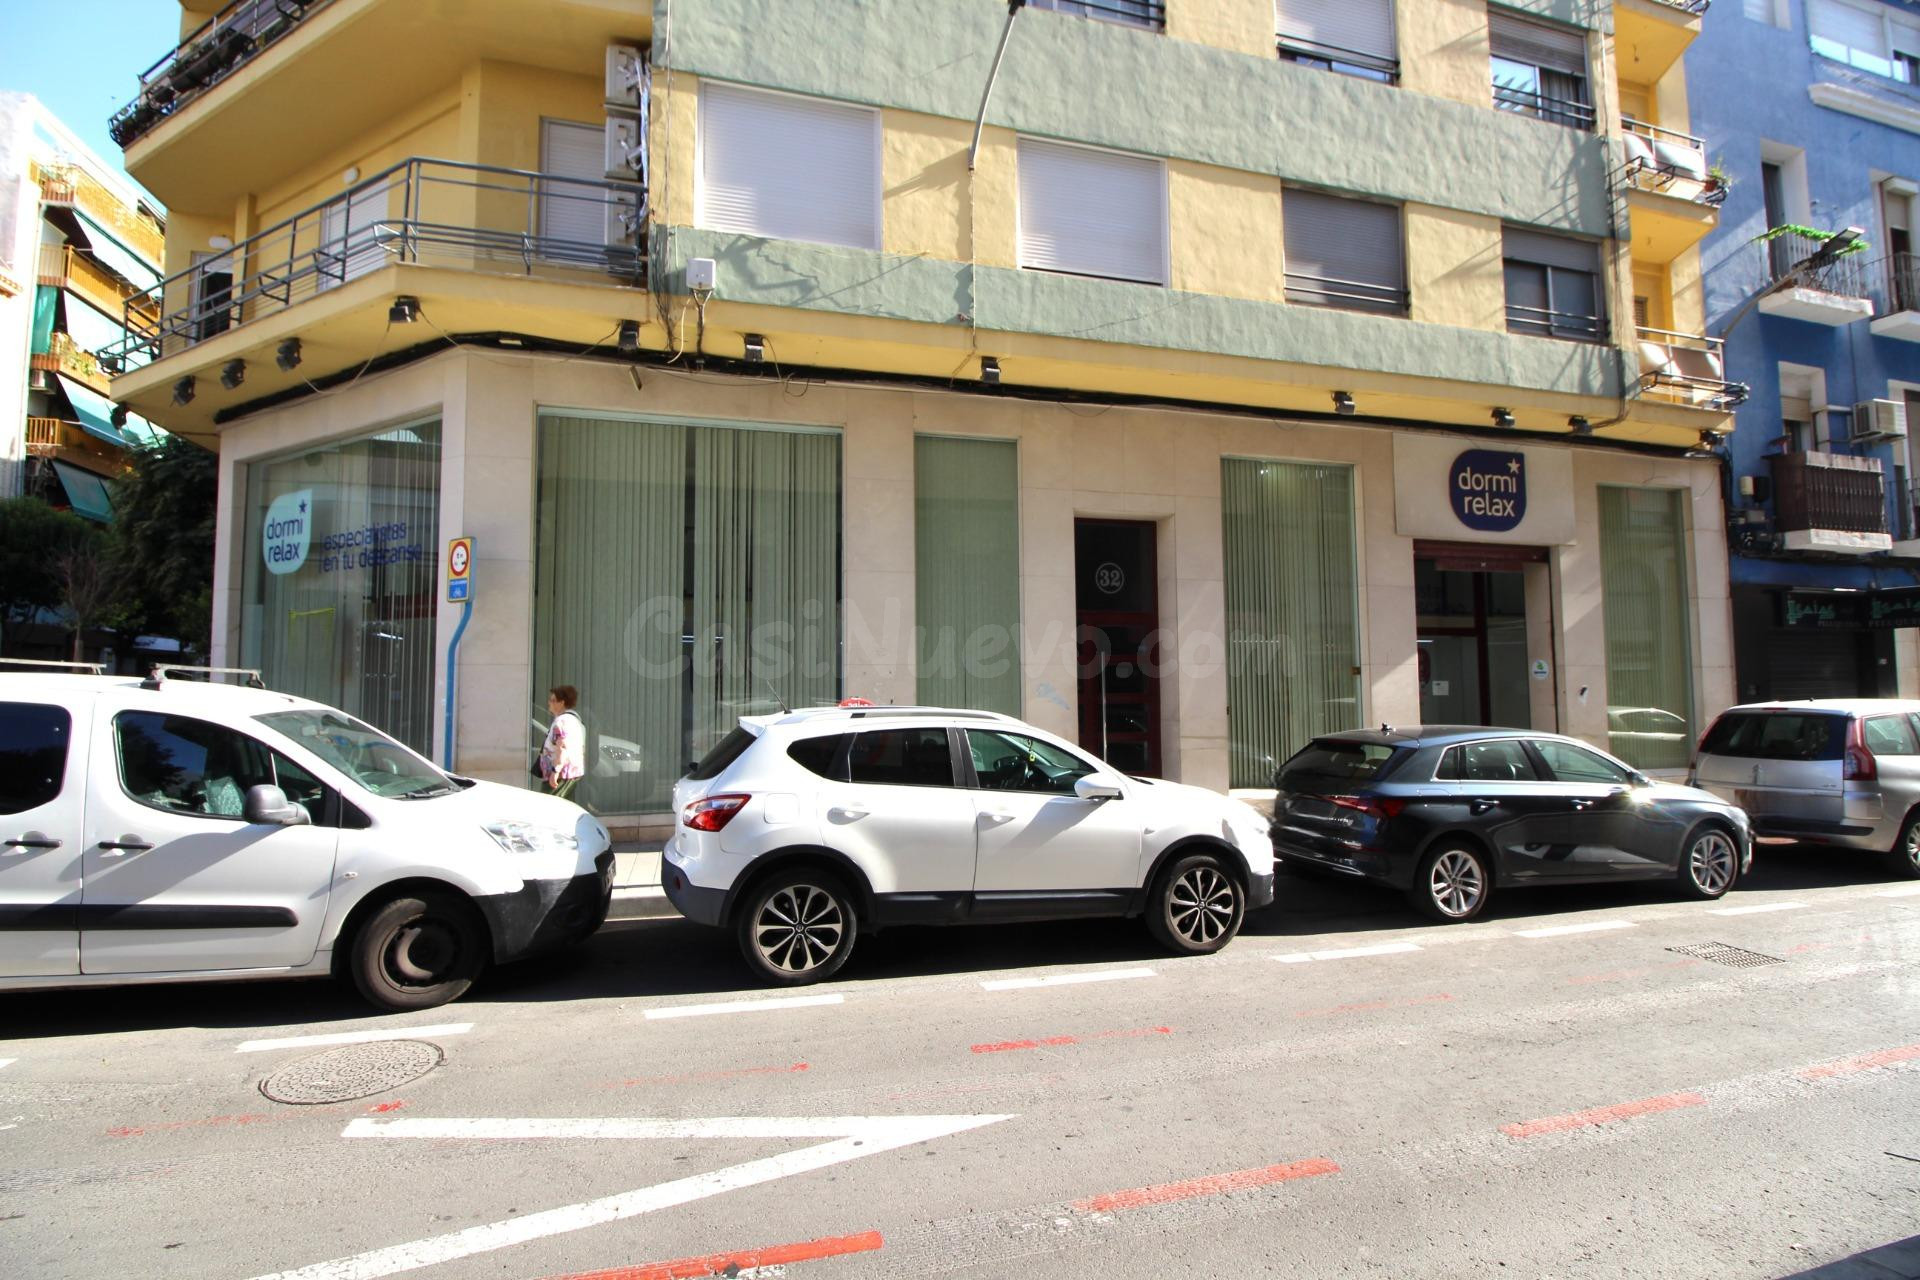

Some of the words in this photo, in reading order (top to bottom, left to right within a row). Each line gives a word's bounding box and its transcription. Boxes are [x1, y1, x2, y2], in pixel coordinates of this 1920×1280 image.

[1458, 466, 1517, 494] dormi
[1464, 492, 1515, 518] relax
[267, 517, 304, 540] dormi
[268, 540, 301, 563] relax
[323, 556, 338, 573] en
[343, 551, 354, 570] tu
[1100, 569, 1121, 588] 32
